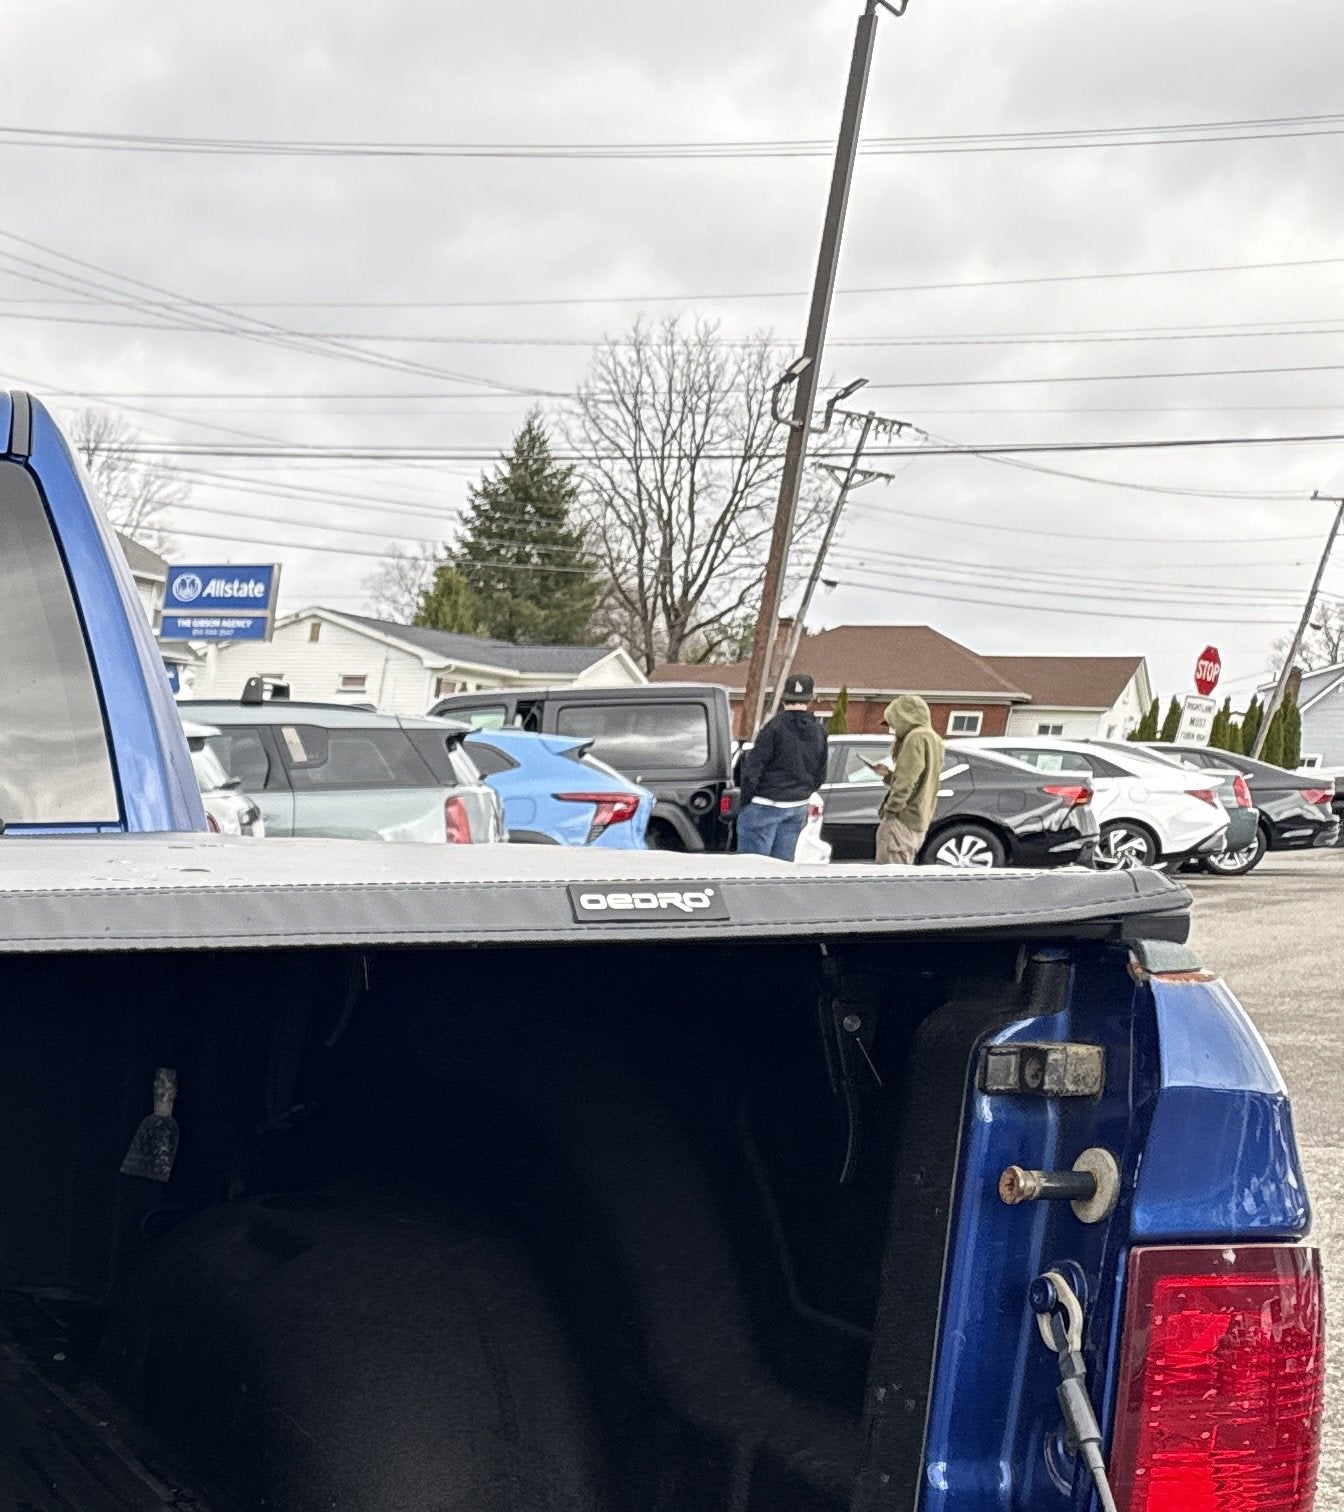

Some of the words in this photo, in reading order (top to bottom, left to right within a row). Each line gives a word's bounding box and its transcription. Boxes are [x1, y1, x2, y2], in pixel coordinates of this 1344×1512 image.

[202, 578, 265, 598] Allstate
[1196, 659, 1220, 683] STOP
[579, 890, 711, 913] OEDRO
